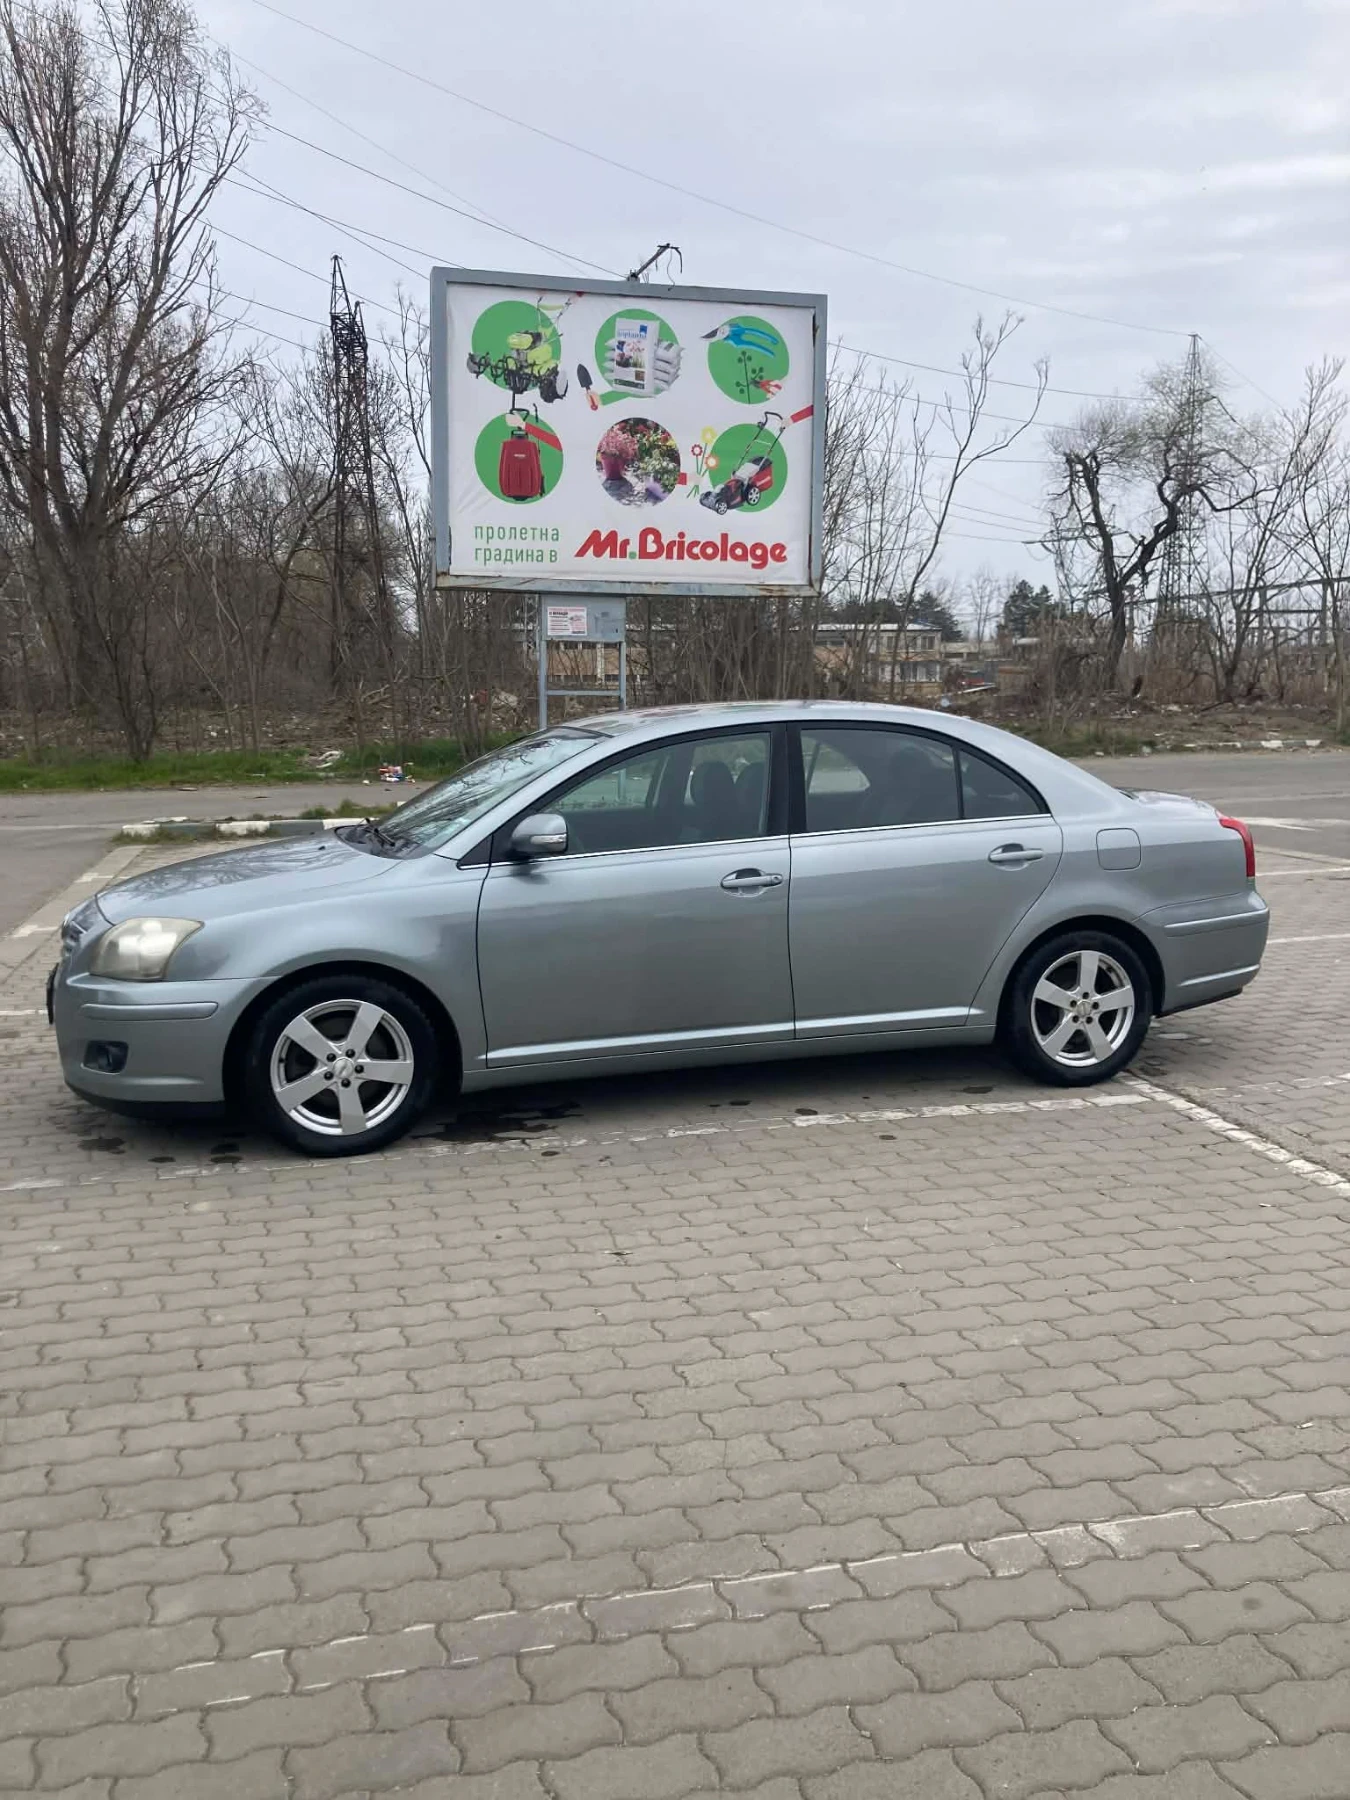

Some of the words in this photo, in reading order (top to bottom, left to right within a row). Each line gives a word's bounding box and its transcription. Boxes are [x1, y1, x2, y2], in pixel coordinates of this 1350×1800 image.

[474, 526, 560, 544] пролетна
[474, 547, 544, 566] градина
[549, 549, 558, 563] в
